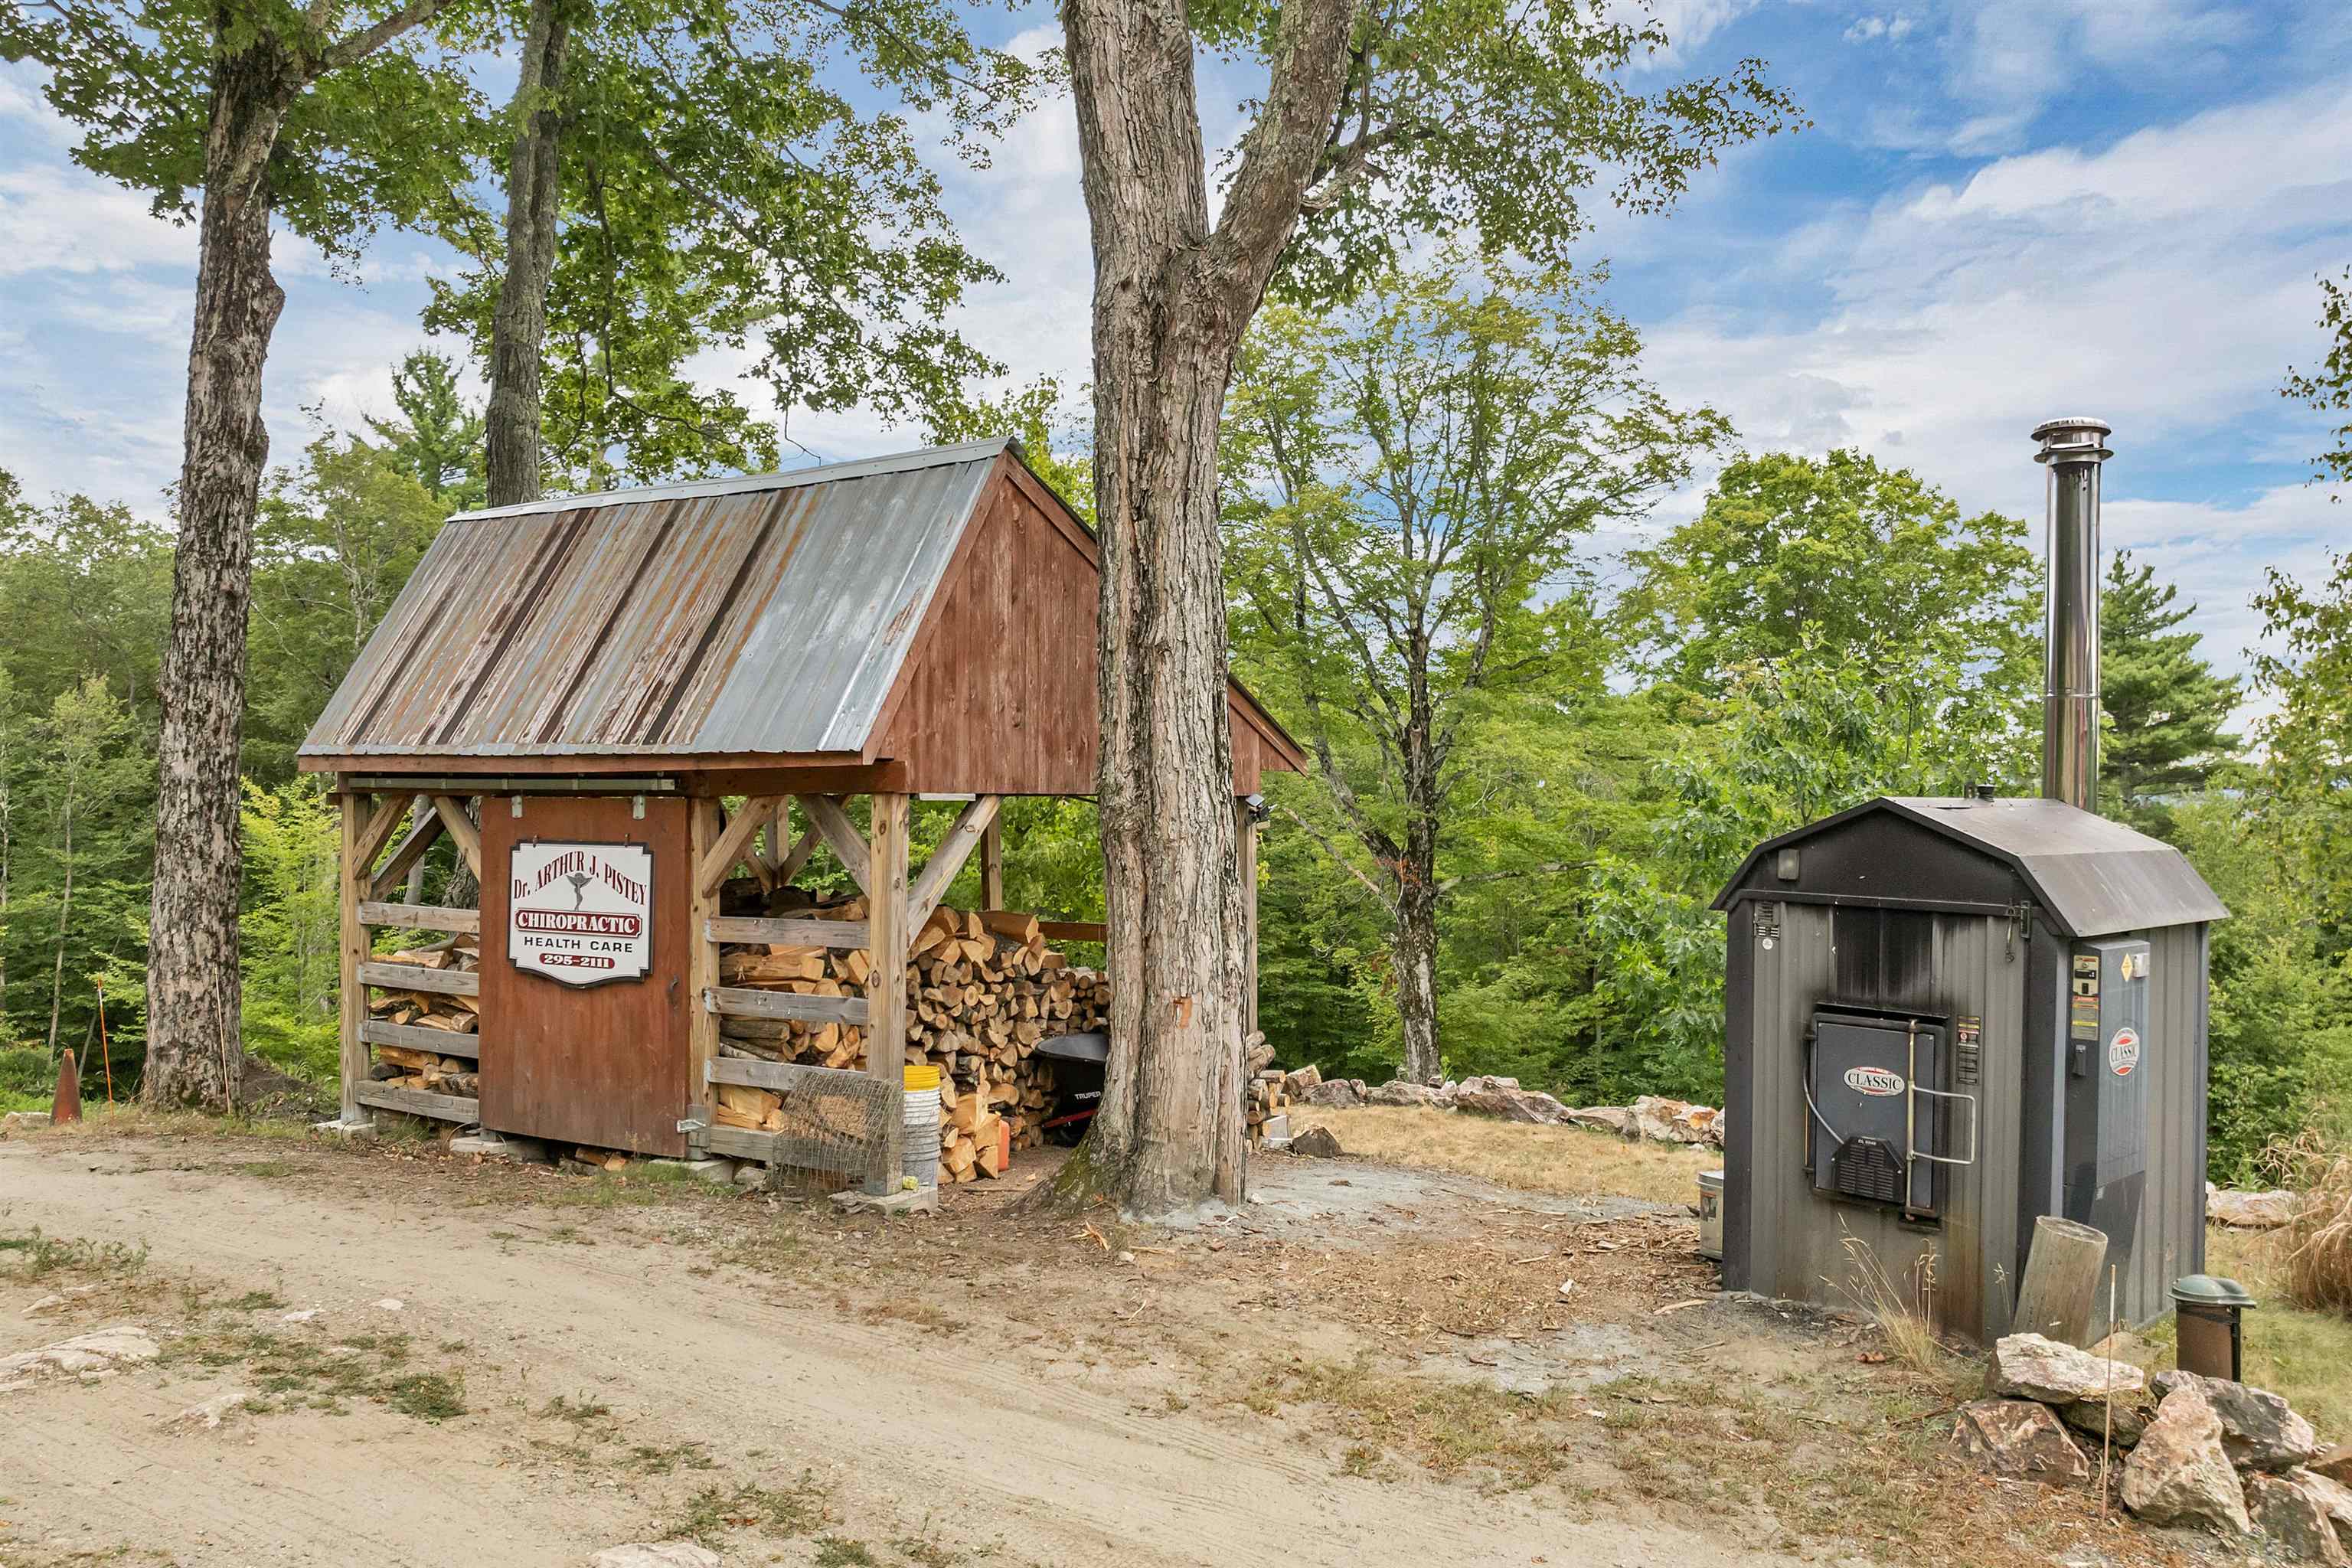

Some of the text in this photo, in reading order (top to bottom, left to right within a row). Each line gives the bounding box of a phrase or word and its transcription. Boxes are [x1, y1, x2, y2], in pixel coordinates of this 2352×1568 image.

[514, 851, 648, 906] Dr. ARTHUR J. PISTEY
[517, 912, 635, 934] CHIROPRACTIC
[524, 936, 633, 953] HEALTH CARE
[544, 954, 609, 969] 295-2111
[2111, 1043, 2138, 1062] CLASSIC
[1847, 1072, 1902, 1091] CLASSIC
[1073, 1090, 1102, 1100] TRUPER
